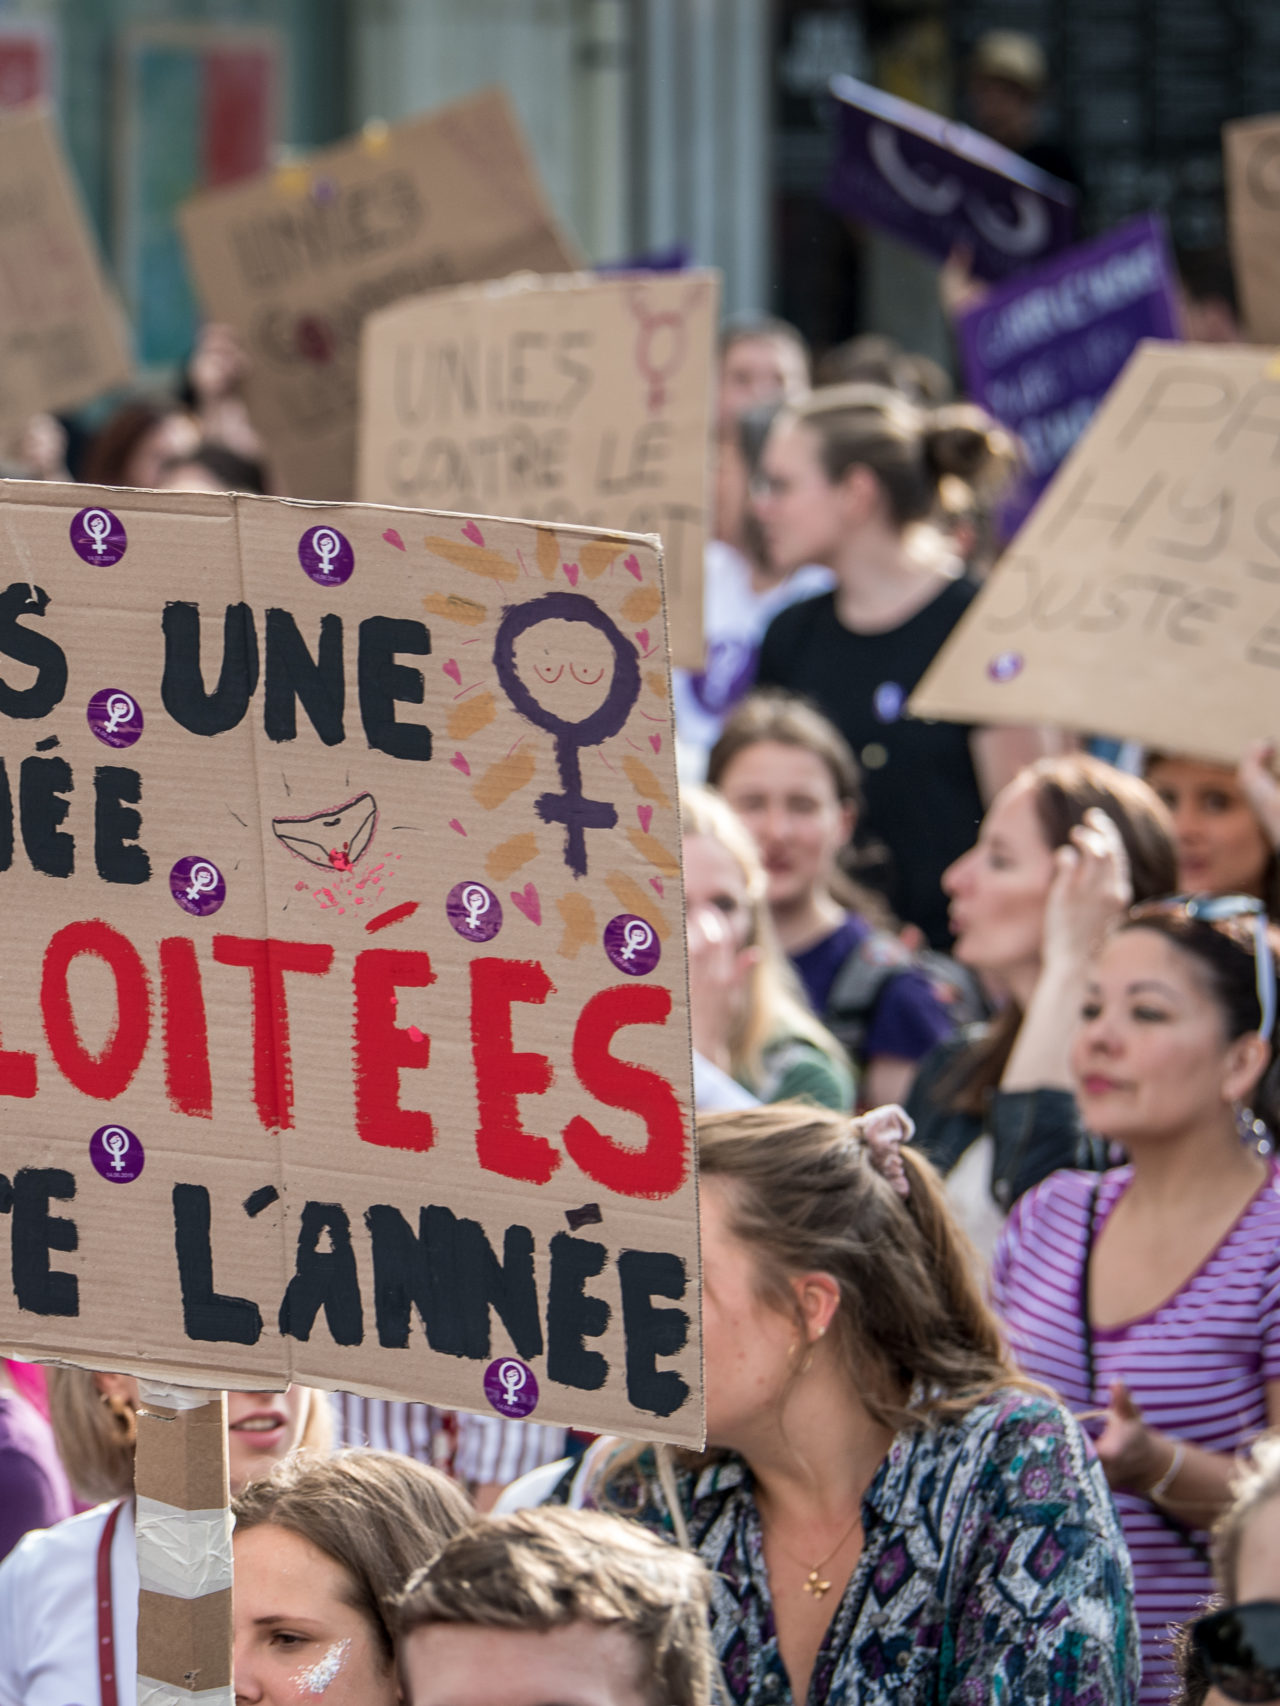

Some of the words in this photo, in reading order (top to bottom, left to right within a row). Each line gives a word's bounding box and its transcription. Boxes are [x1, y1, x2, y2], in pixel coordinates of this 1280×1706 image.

[394, 330, 598, 428] UNIES
[160, 600, 434, 762] UNE
[172, 1183, 692, 1418] L'ANNÉE
